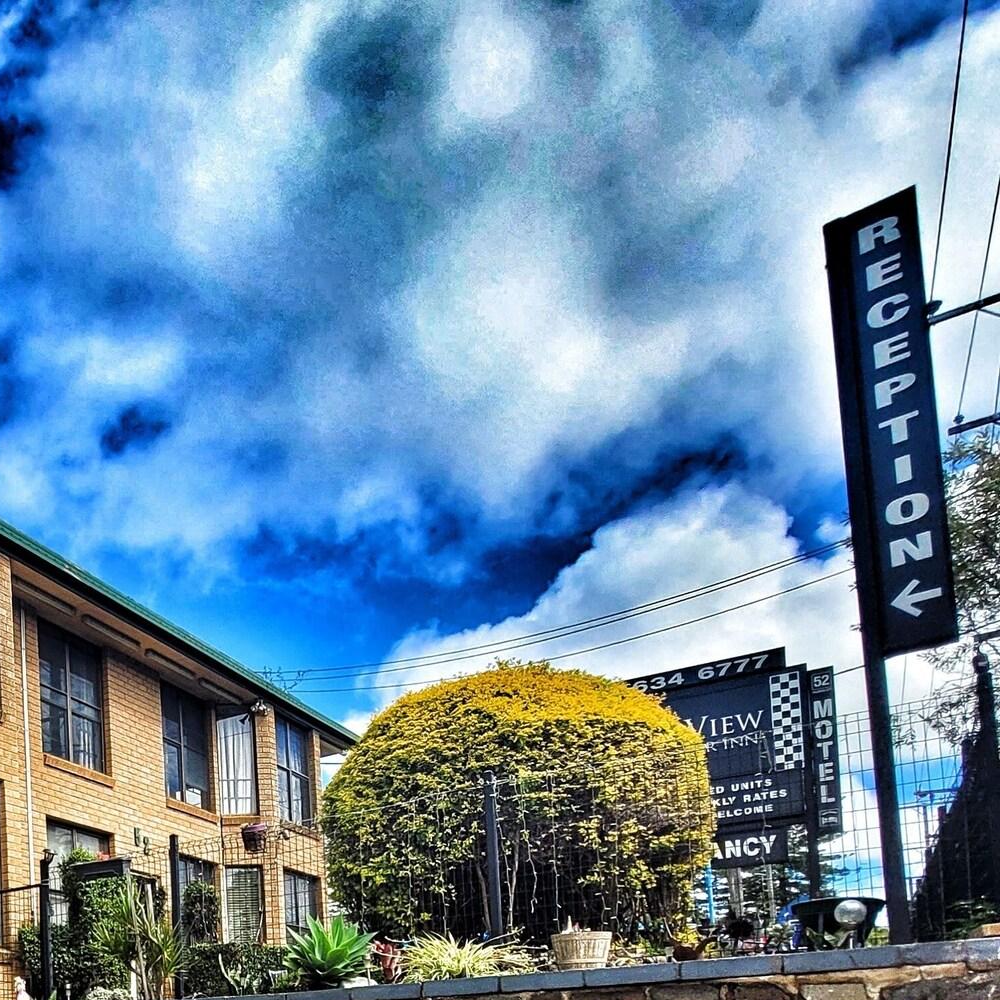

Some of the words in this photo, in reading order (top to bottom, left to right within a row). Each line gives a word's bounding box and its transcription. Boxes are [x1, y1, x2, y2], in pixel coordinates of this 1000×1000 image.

[857, 215, 934, 568] RECEPTION
[627, 672, 685, 693] 634
[697, 655, 769, 680] 6777
[813, 674, 830, 687] 52
[813, 699, 835, 803] MOTEL
[710, 786, 725, 795] ED
[731, 779, 772, 792] UNITS
[711, 796, 736, 808] KLY
[743, 789, 788, 803] RATES
[715, 804, 774, 818] ELCOME
[711, 835, 777, 859] ANCY
